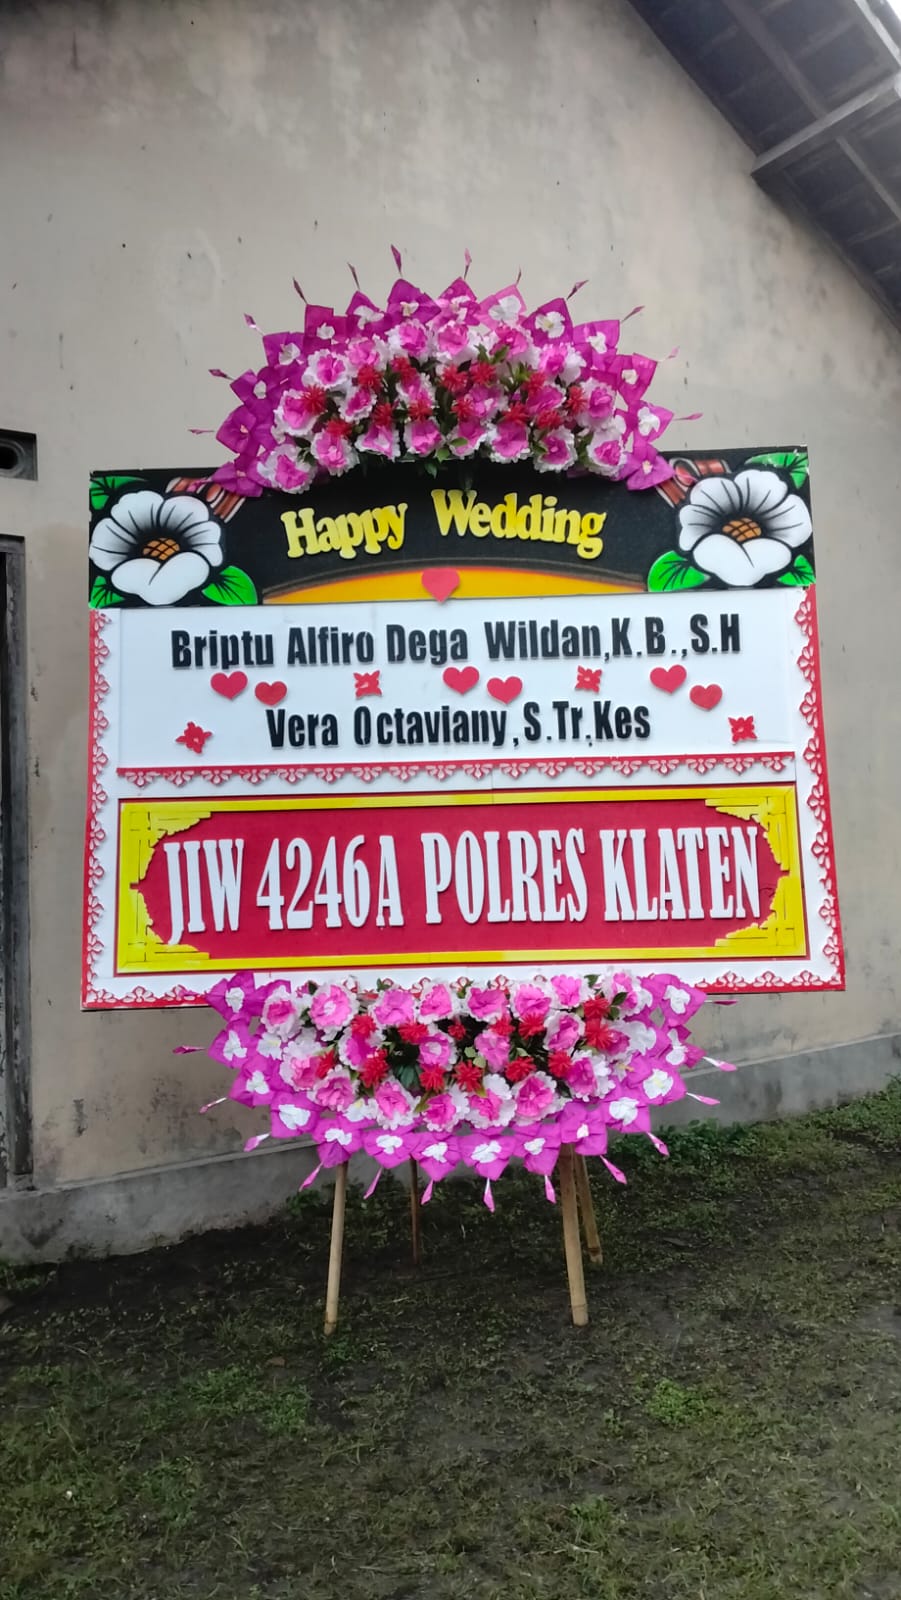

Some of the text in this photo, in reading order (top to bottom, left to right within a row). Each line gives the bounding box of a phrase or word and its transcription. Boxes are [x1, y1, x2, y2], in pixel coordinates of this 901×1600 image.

[280, 488, 607, 559] Happy Wedding
[171, 629, 275, 670] Briptu
[287, 625, 375, 666] Alfiro
[386, 623, 469, 666] Dega
[265, 708, 339, 748] Vera
[163, 838, 244, 946] JIW
[420, 827, 588, 925] POLRES
[599, 826, 760, 922] KLATEN
